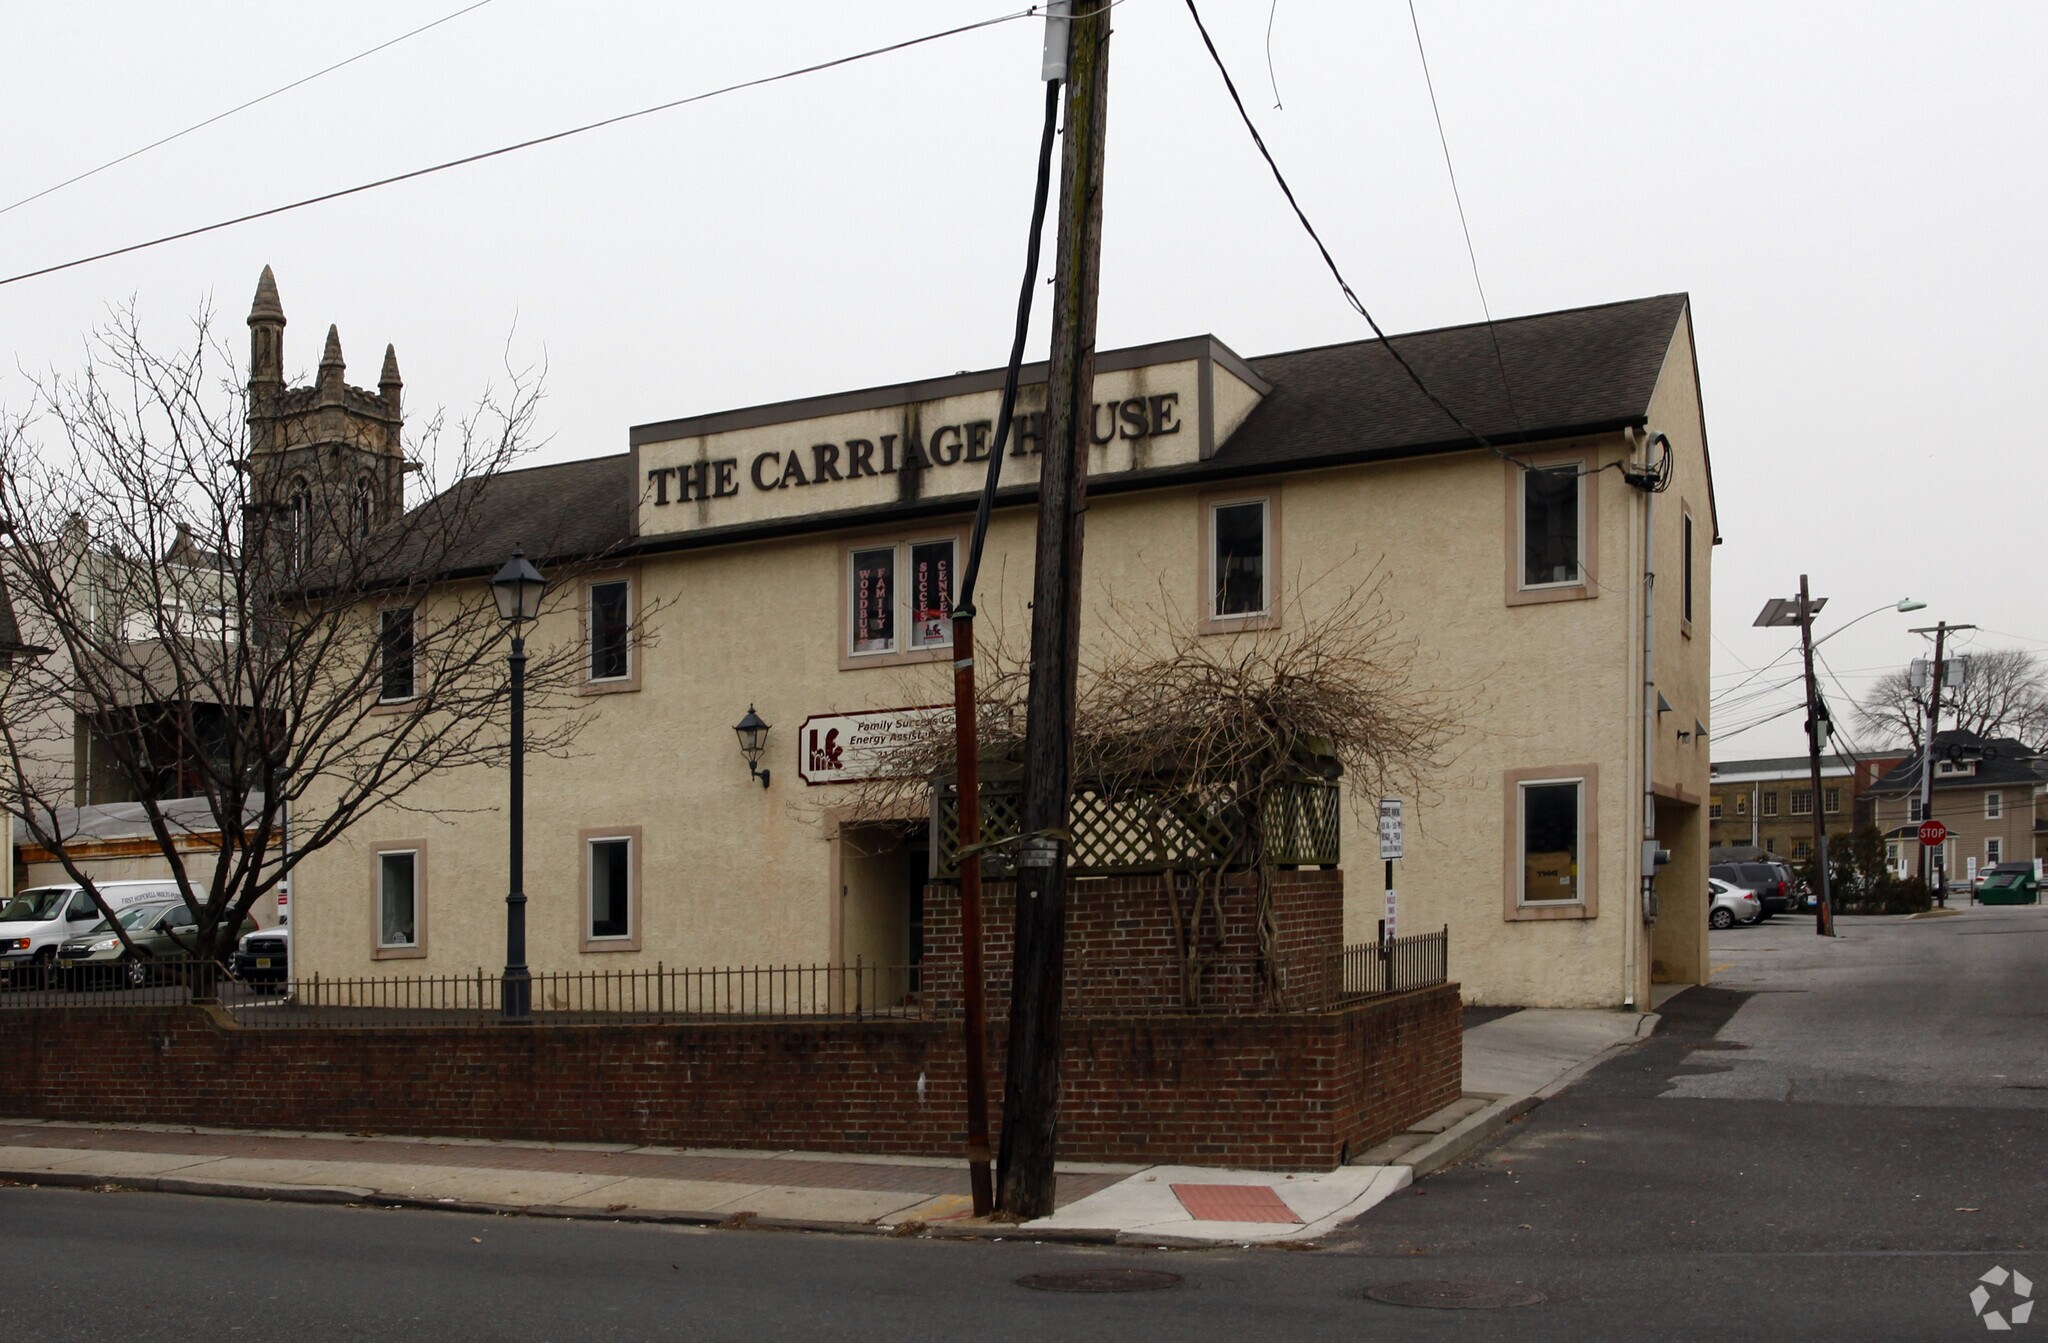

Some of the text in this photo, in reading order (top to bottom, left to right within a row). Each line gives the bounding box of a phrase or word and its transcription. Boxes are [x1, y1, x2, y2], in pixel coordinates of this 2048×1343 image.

[648, 393, 1181, 506] THE CARRIAGE HUSE
[859, 569, 871, 646] WOODBURY
[876, 568, 886, 629] FAMILY
[919, 562, 929, 630] SUCCESS
[937, 560, 948, 622] CENTER
[849, 735, 886, 746] Energy
[857, 719, 893, 732] Family
[1920, 828, 1945, 838] STOP
[134, 892, 156, 902] HOPEWELL
